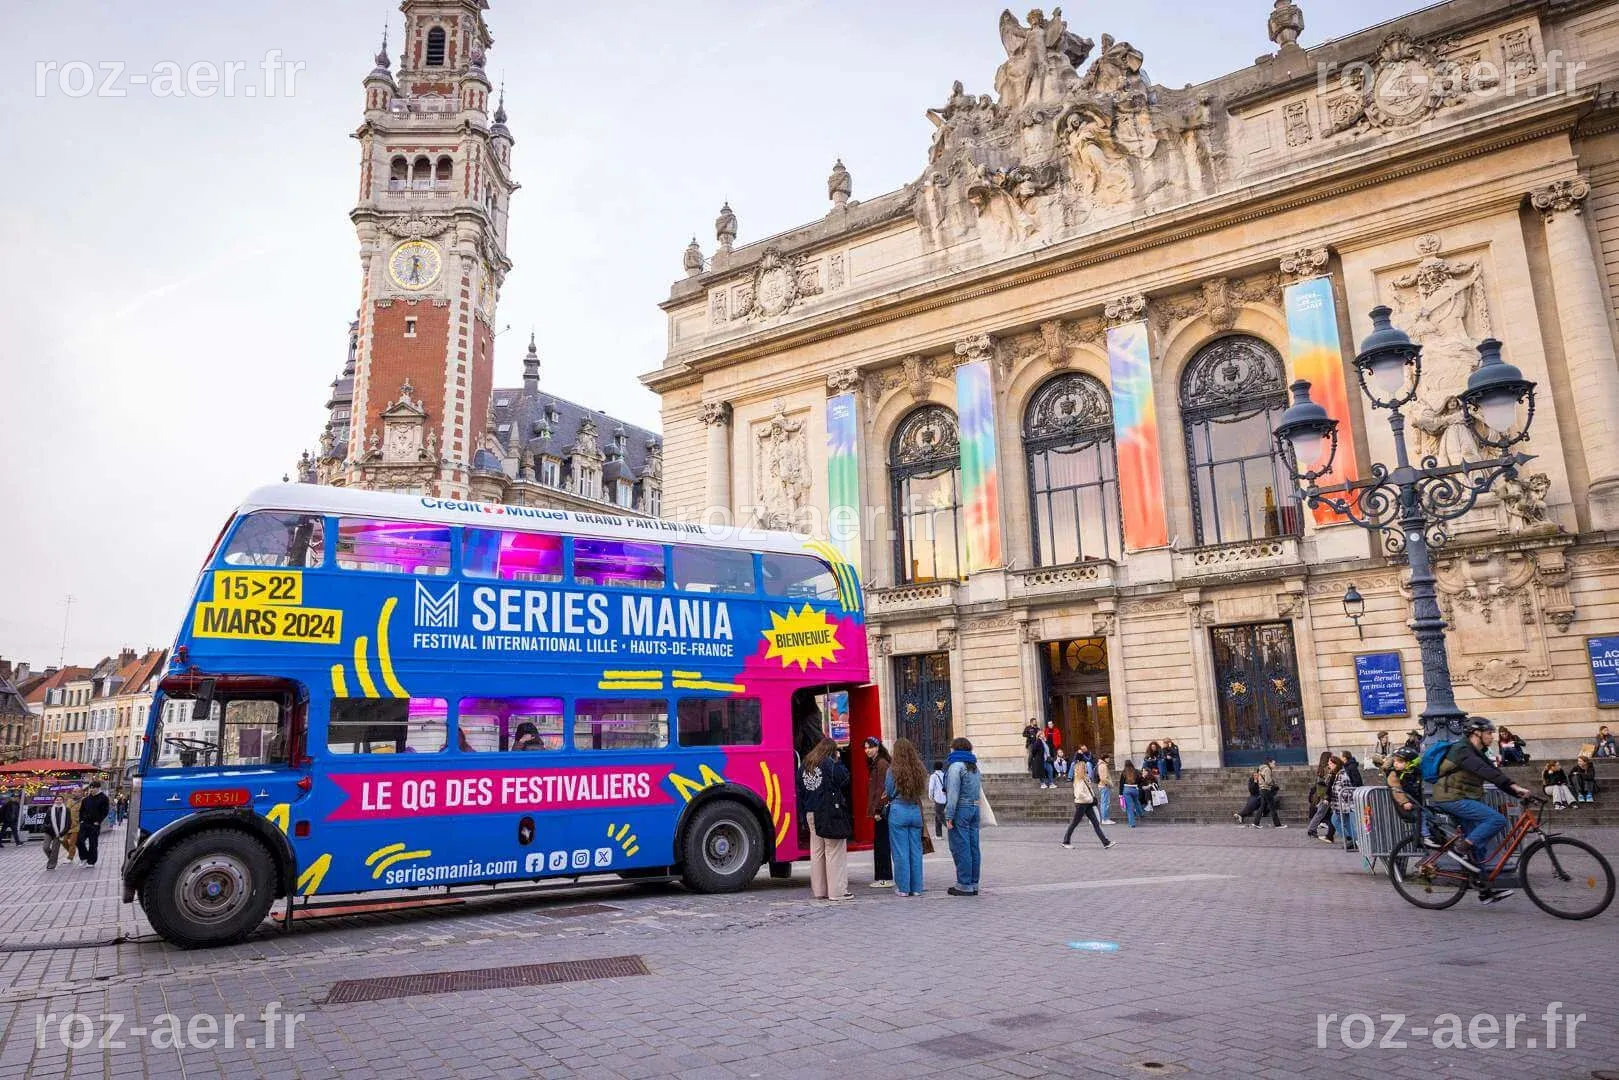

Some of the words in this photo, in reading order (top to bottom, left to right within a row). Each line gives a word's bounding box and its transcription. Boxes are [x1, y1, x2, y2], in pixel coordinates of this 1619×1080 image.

[507, 506, 569, 520] Mutuel
[575, 513, 622, 526] GRAND
[627, 517, 706, 534] PARTENAIRE
[221, 576, 296, 600] 15>22
[202, 607, 277, 636] MARS
[283, 612, 335, 639] 2024
[472, 586, 609, 635] SERIES
[623, 595, 733, 640] MANIA
[413, 633, 477, 650] FESTIVAL
[482, 635, 583, 653] INTERNATIONAL
[587, 638, 618, 654] LILLE
[630, 641, 734, 657] HAUTS-DE-FRANCE
[776, 629, 832, 649] BIENVENUE
[361, 781, 393, 811] LE
[401, 779, 436, 811] QG
[445, 777, 493, 807] DES
[501, 772, 651, 805] FESTIVALIERS
[385, 859, 518, 885] seriesmania.com
